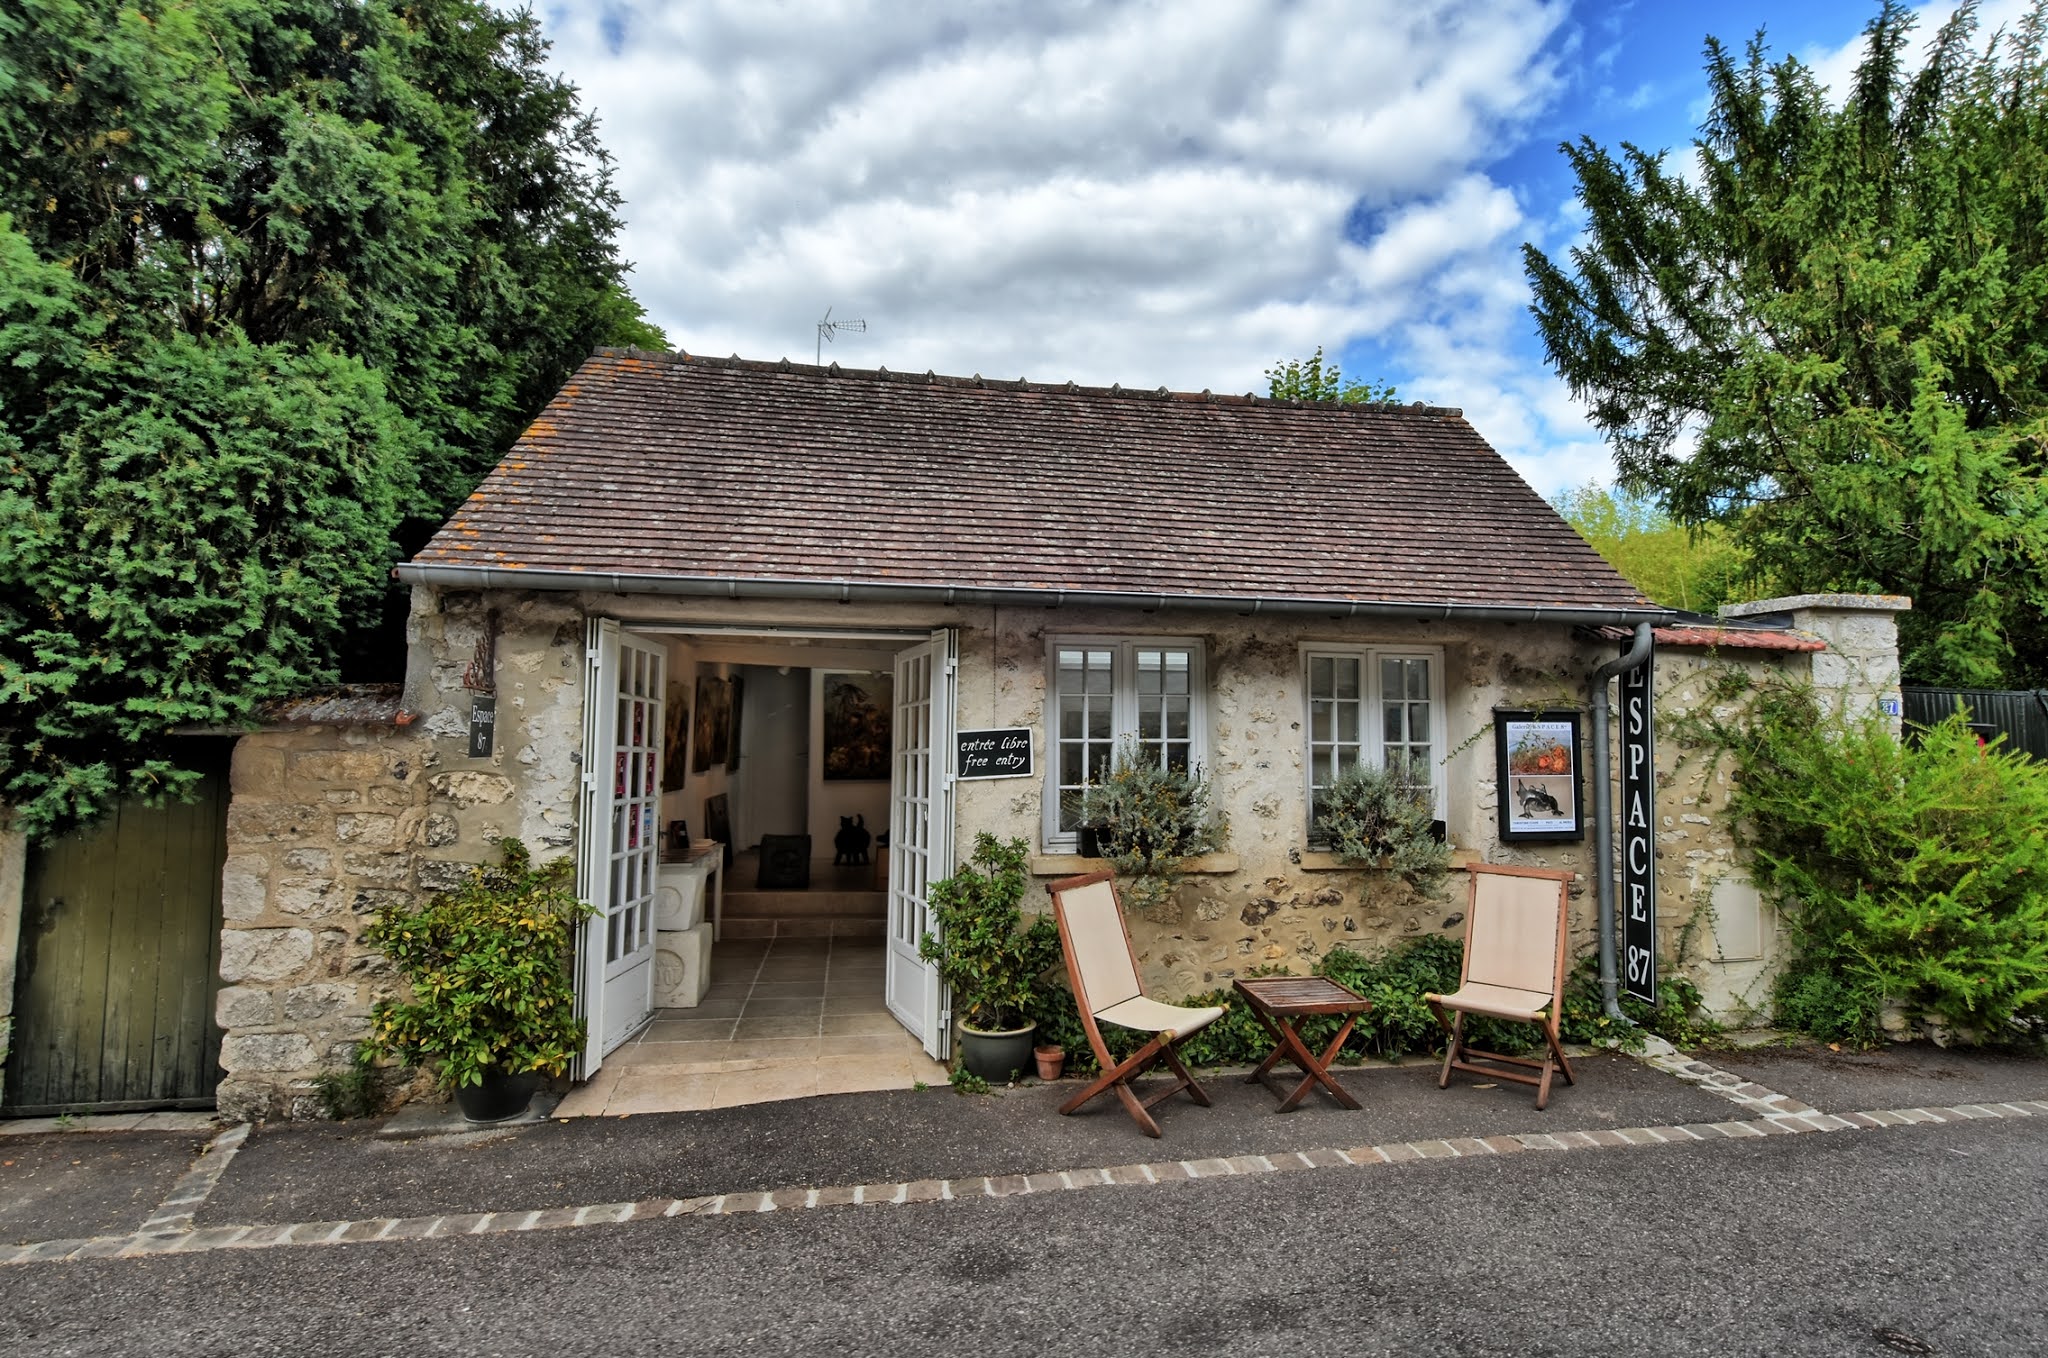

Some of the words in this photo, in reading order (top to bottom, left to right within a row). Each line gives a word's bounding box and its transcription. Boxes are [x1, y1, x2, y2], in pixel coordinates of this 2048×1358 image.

[472, 705, 493, 727] Espace
[477, 732, 486, 752] 87
[961, 738, 996, 751] entrée
[1001, 737, 1028, 749] libre
[962, 754, 989, 776] free
[995, 753, 1026, 769] entry
[1628, 665, 1647, 922] ESPACE
[1628, 945, 1651, 985] 87
